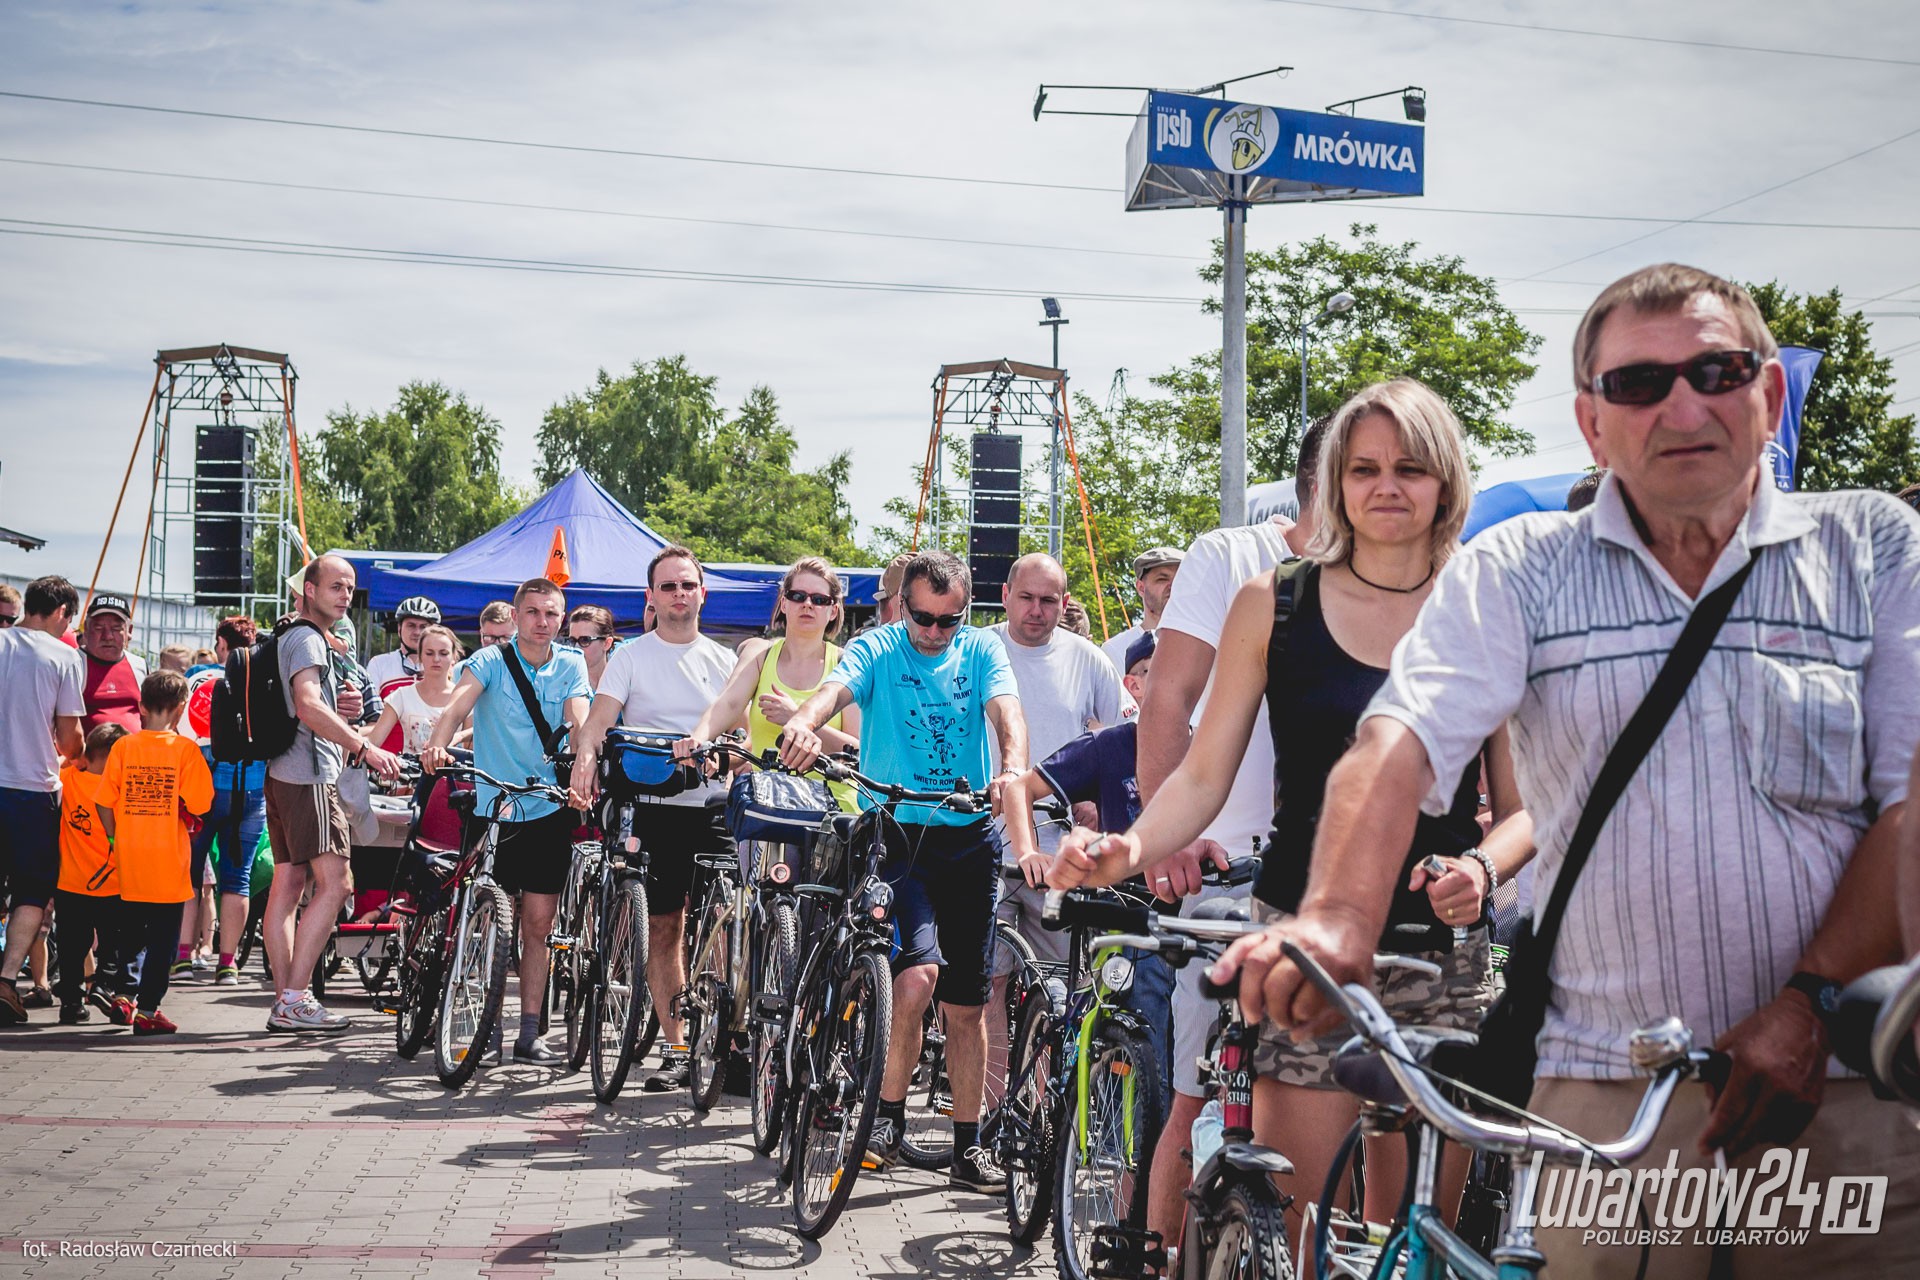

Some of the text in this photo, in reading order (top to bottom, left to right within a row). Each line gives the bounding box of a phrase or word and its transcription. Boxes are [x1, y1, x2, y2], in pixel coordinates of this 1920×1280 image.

[1157, 109, 1192, 151] psb
[1294, 131, 1416, 173] MRÓWKA
[928, 768, 953, 776] XX
[1227, 1091, 1250, 1105] STUFF
